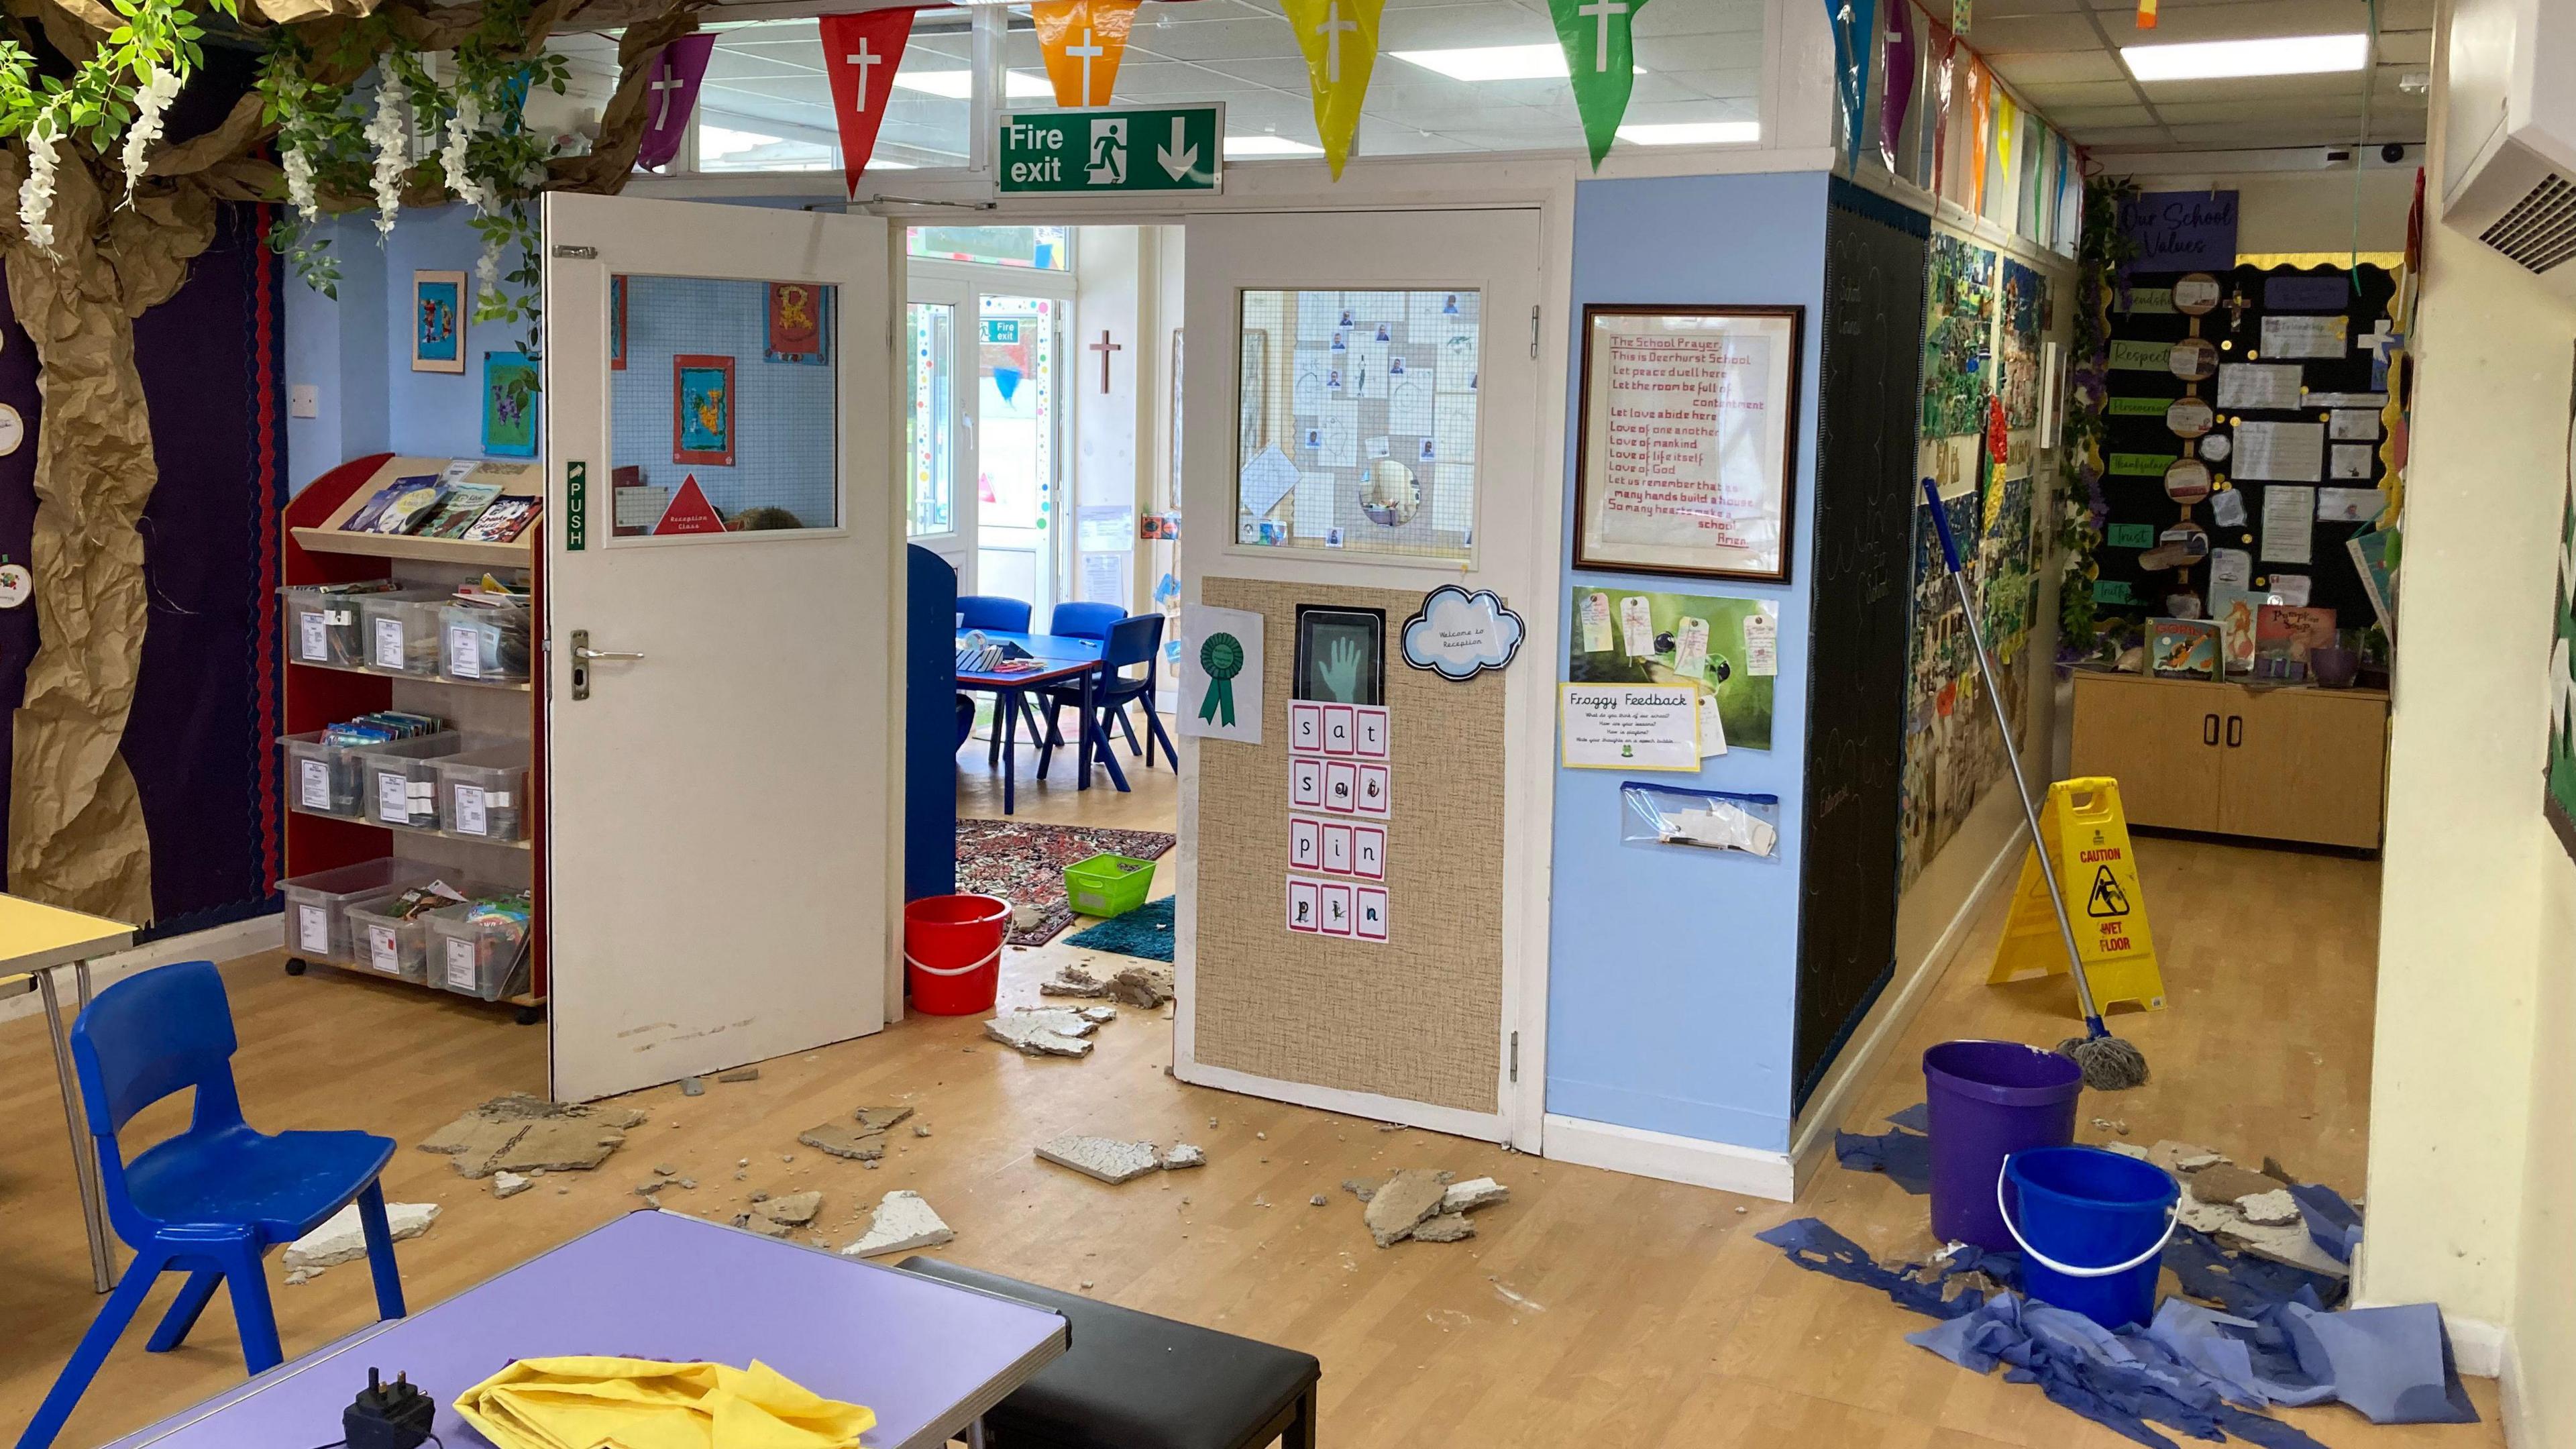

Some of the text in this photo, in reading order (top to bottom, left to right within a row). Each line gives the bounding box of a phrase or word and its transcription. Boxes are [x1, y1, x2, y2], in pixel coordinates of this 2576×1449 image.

[1009, 124, 1064, 150] Fire
[1010, 156, 1061, 182] exit
[2121, 202, 2233, 231] Our School
[2144, 231, 2207, 258] Values
[996, 322, 1015, 331] Fire
[997, 331, 1014, 341] exit
[1611, 336, 1633, 347] The
[1636, 337, 1675, 347] School
[1612, 351, 1751, 365] This is Deerhurst School
[1613, 365, 1727, 378] Let peace dwell here
[1612, 379, 1629, 390] Let
[1631, 380, 1650, 390] the
[1652, 383, 1680, 392] room
[1682, 381, 1697, 392] be
[1698, 381, 1717, 396] full
[1693, 398, 1764, 411] contentment
[1611, 407, 1717, 421] Let love abide here
[1610, 421, 1637, 432] Love
[1638, 424, 1651, 437] of
[1674, 427, 1719, 437] another
[1610, 435, 1698, 451] Love of mankind
[1610, 448, 1705, 467] Love of life itself
[1609, 461, 1676, 477] Love of God
[1609, 474, 1626, 484] Let
[1627, 478, 1640, 486] us
[1642, 478, 1695, 489] remember
[1696, 480, 1723, 492] that
[1613, 490, 1754, 508] many hands build a house
[570, 482, 583, 545] PUSH
[1608, 498, 1624, 511] So
[1625, 504, 1654, 517] many
[1655, 503, 1693, 516] hearts
[1695, 507, 1723, 519] make
[670, 515, 708, 523] Reception
[1698, 519, 1737, 531] school
[2112, 524, 2147, 545] Trust
[1439, 630, 1472, 638] Welcome
[2283, 619, 2310, 633] Soup
[1443, 639, 1483, 649] Reception
[1570, 693, 1687, 710] Froggy Feedback
[1302, 722, 1376, 742] s a t
[1302, 775, 1312, 792] s
[1334, 780, 1348, 798] a
[1300, 837, 1375, 861] p i n
[2080, 848, 2121, 863] CAUTION
[1365, 904, 1379, 922] n
[2100, 922, 2123, 934] WET
[2099, 937, 2131, 952] FLOOR
